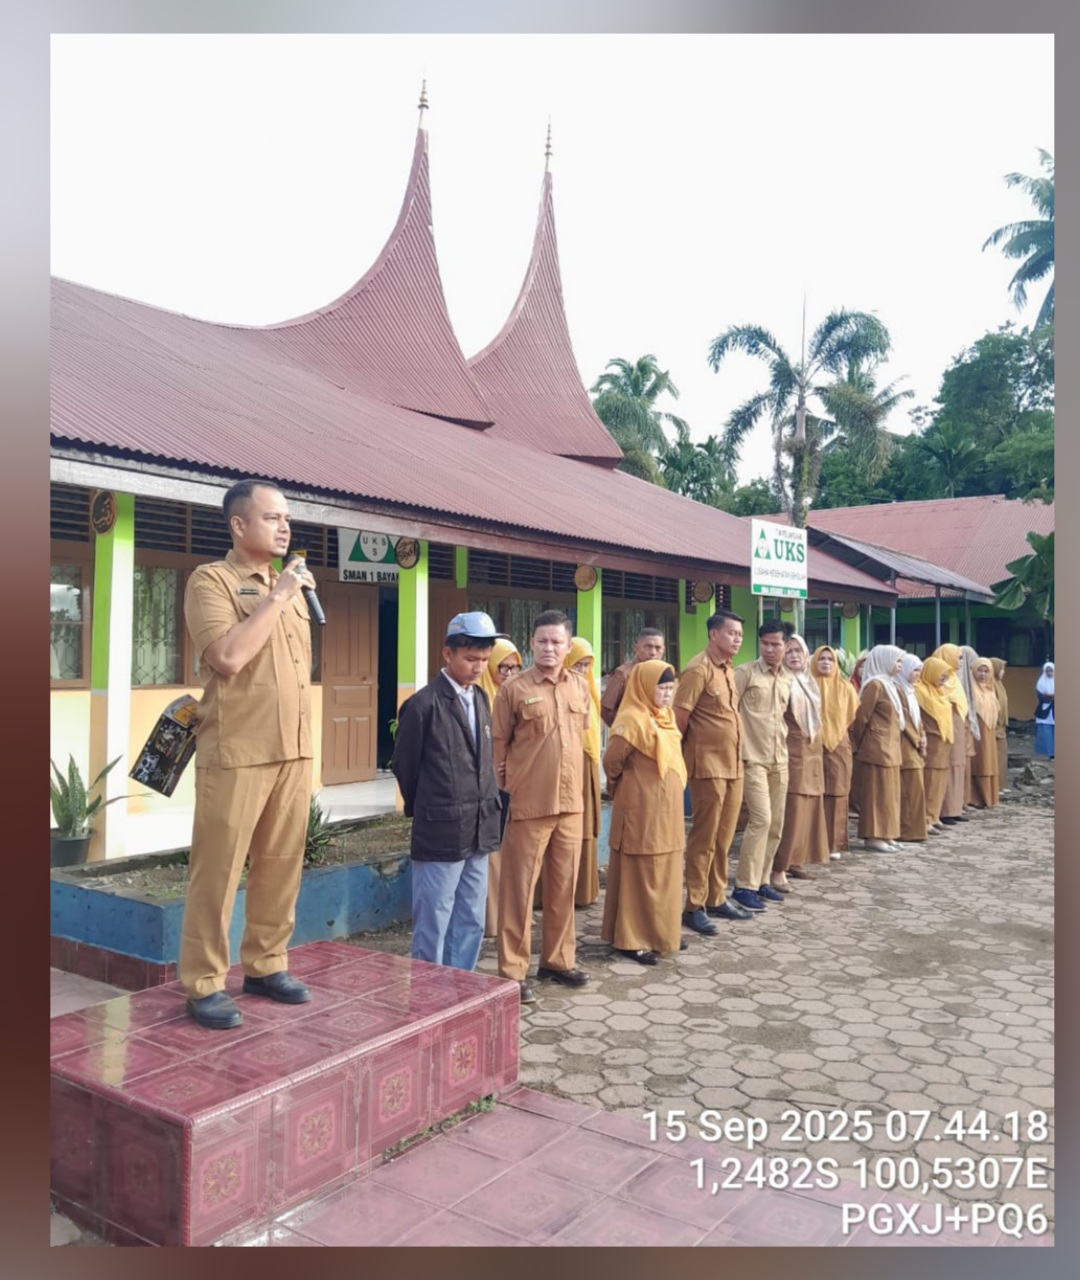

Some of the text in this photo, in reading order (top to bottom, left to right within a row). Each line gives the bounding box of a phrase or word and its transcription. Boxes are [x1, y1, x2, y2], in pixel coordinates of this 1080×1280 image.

[773, 538, 805, 564] UKS
[343, 569, 367, 581] SMAN
[369, 571, 374, 582] 1
